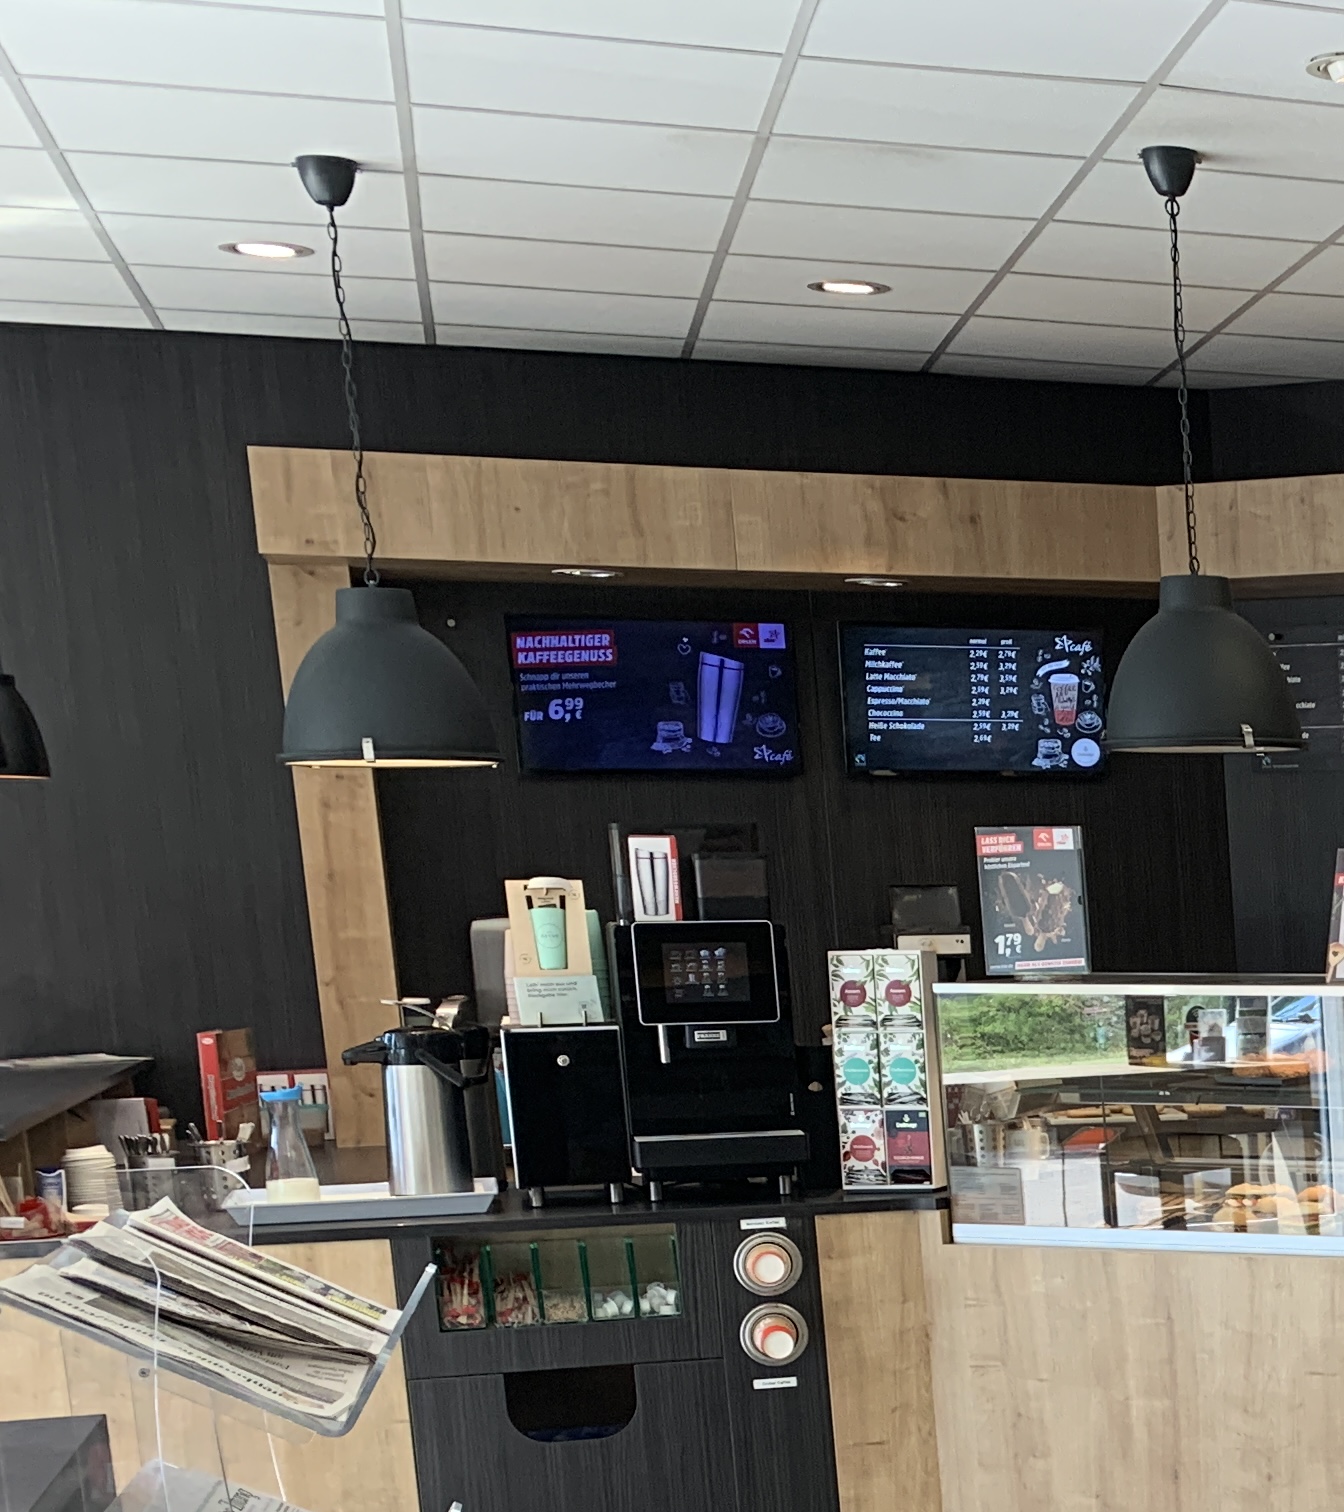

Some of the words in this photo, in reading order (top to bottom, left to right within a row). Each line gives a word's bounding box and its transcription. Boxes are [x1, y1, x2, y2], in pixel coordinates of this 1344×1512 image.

[515, 633, 611, 649] NACHHALTIGER
[517, 649, 613, 664] KAFFEEGENUSS
[524, 710, 543, 721] FÜR
